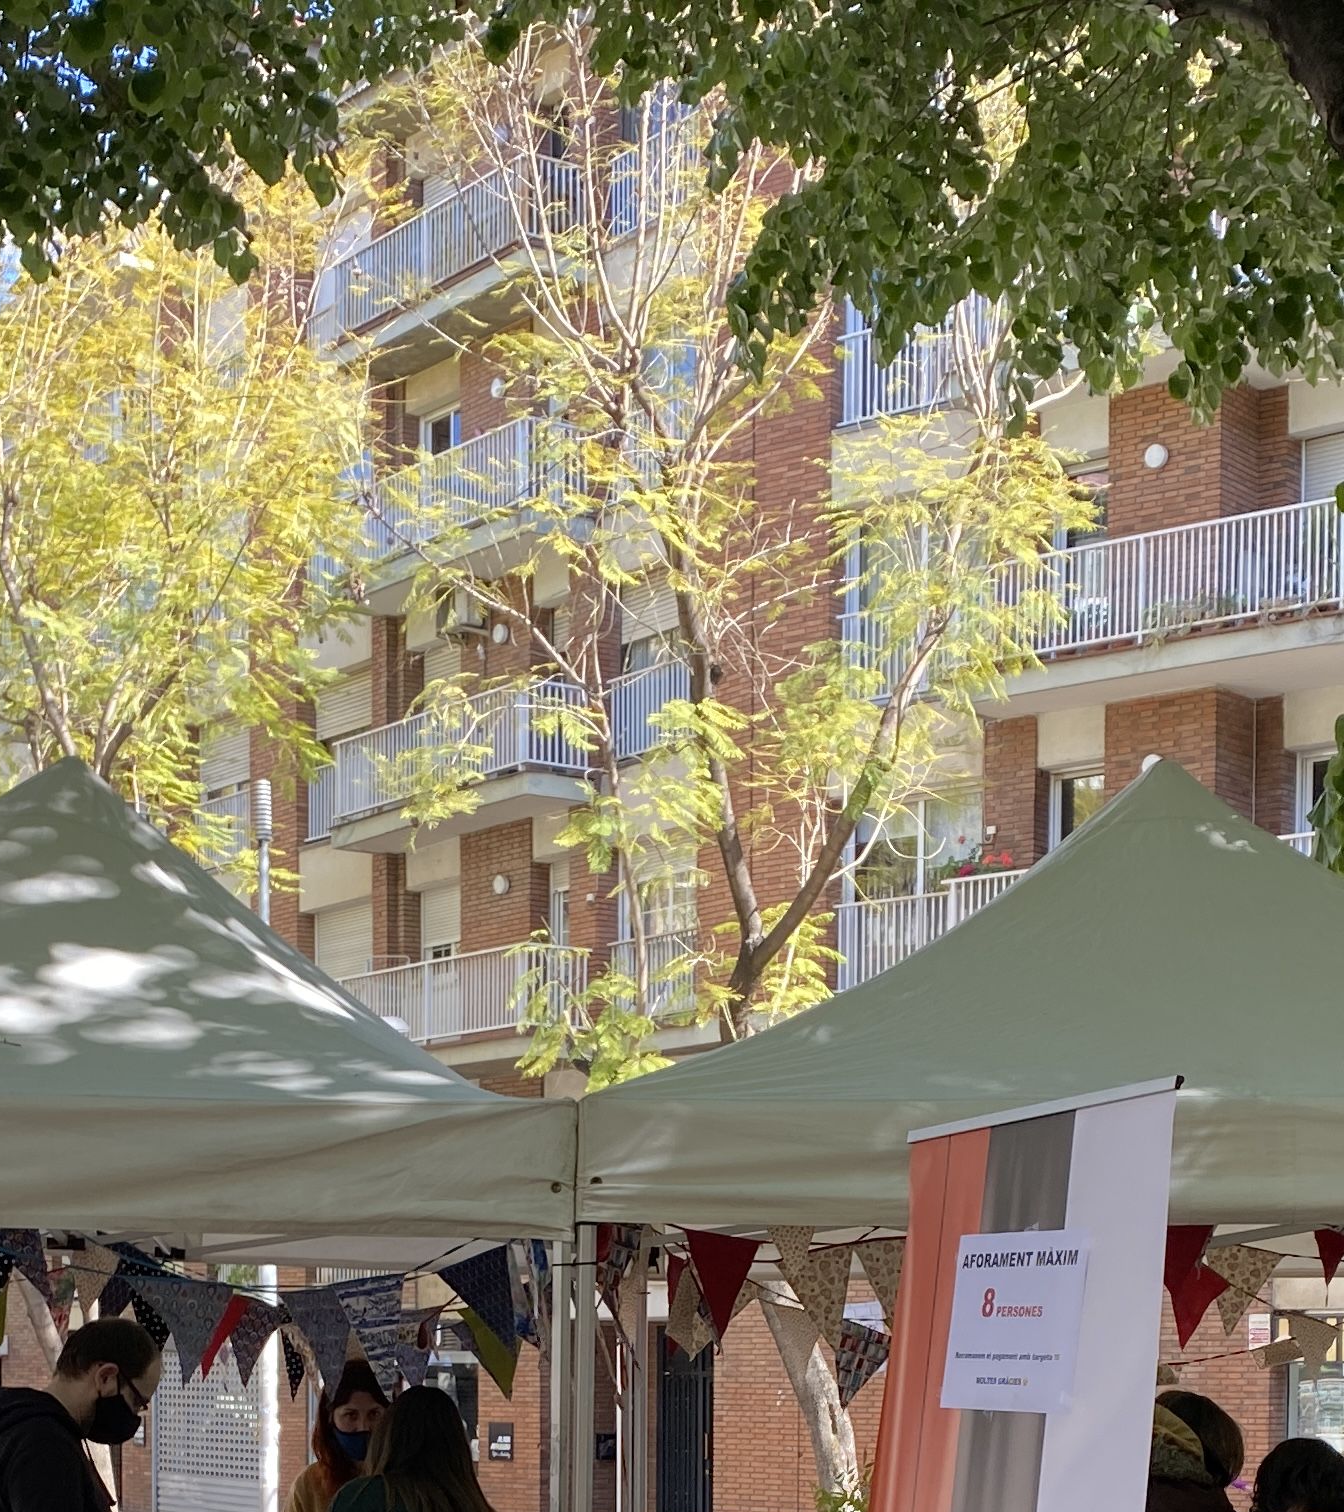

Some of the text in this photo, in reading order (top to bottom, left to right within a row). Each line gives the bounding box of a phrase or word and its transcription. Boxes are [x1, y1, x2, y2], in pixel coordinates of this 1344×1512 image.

[962, 1247, 1079, 1269] AFORAMENT MÀXIM
[982, 1288, 1043, 1317] 8 PERSONES
